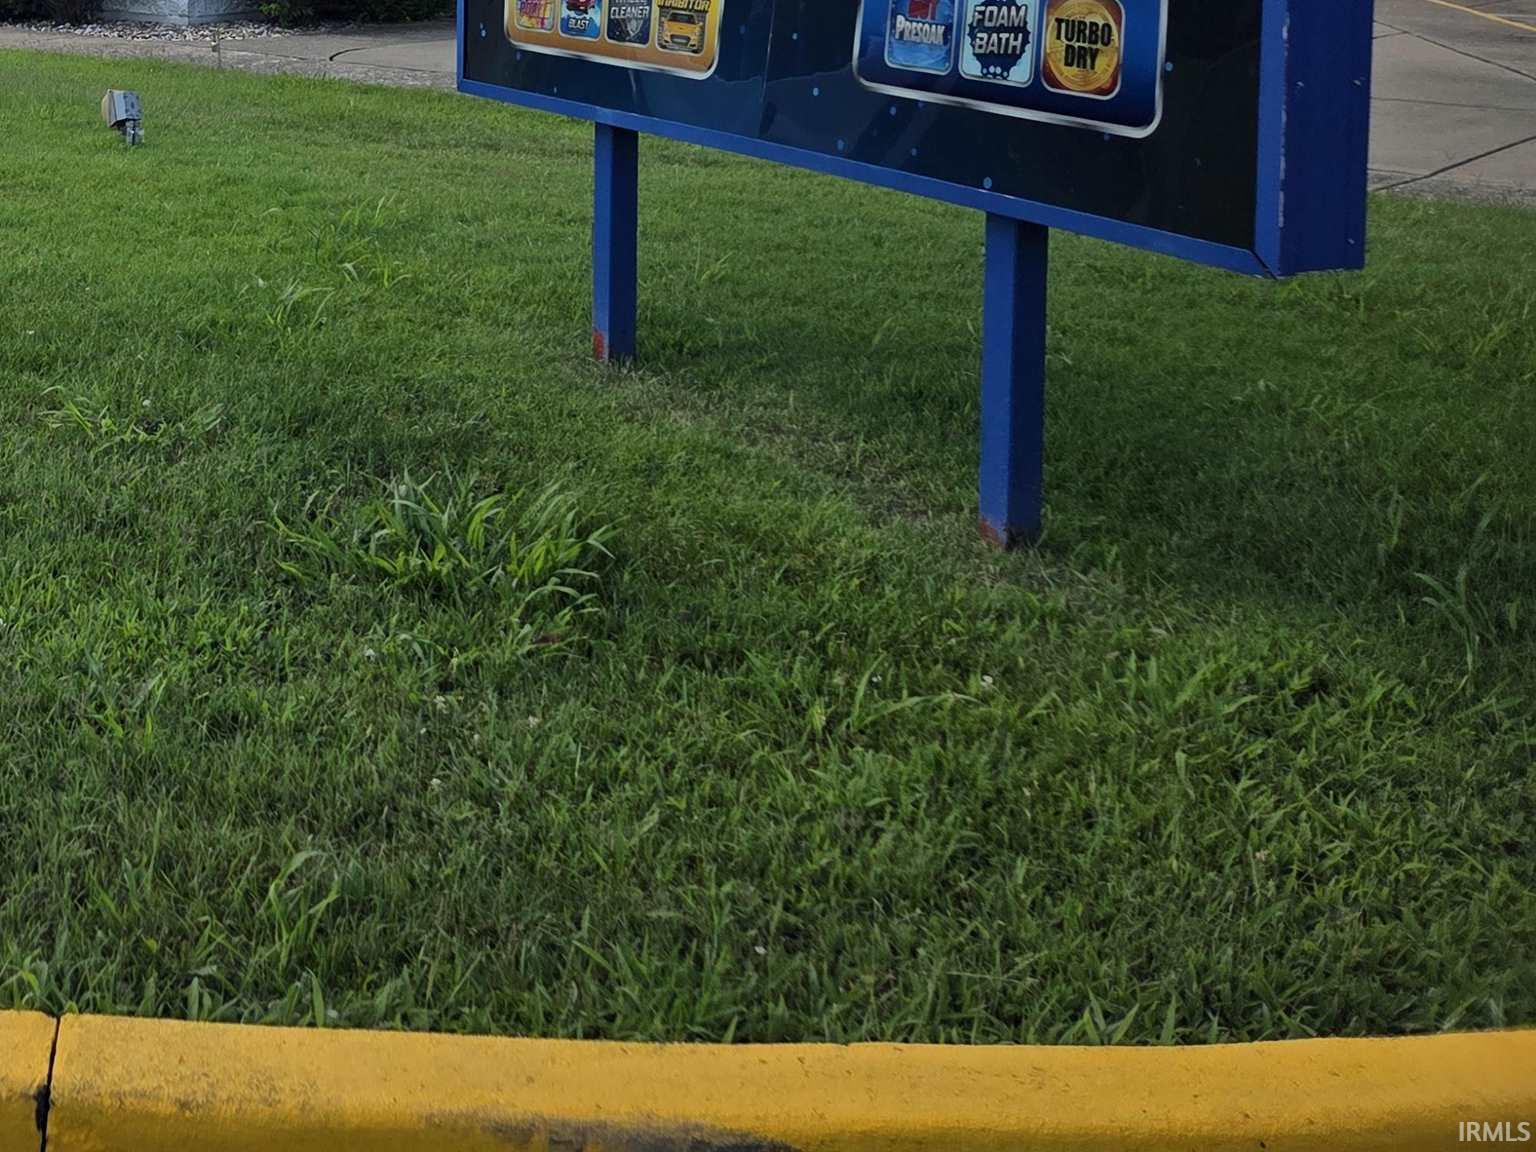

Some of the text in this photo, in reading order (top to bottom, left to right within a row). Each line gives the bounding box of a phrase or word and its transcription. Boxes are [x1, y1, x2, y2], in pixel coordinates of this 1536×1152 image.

[568, 19, 590, 30] BLAST
[610, 5, 650, 19] CLEANER
[972, 1, 1026, 28] FOAM
[975, 30, 1023, 55] BATH
[1054, 17, 1114, 47] TURBO
[1063, 44, 1099, 71] DRY
